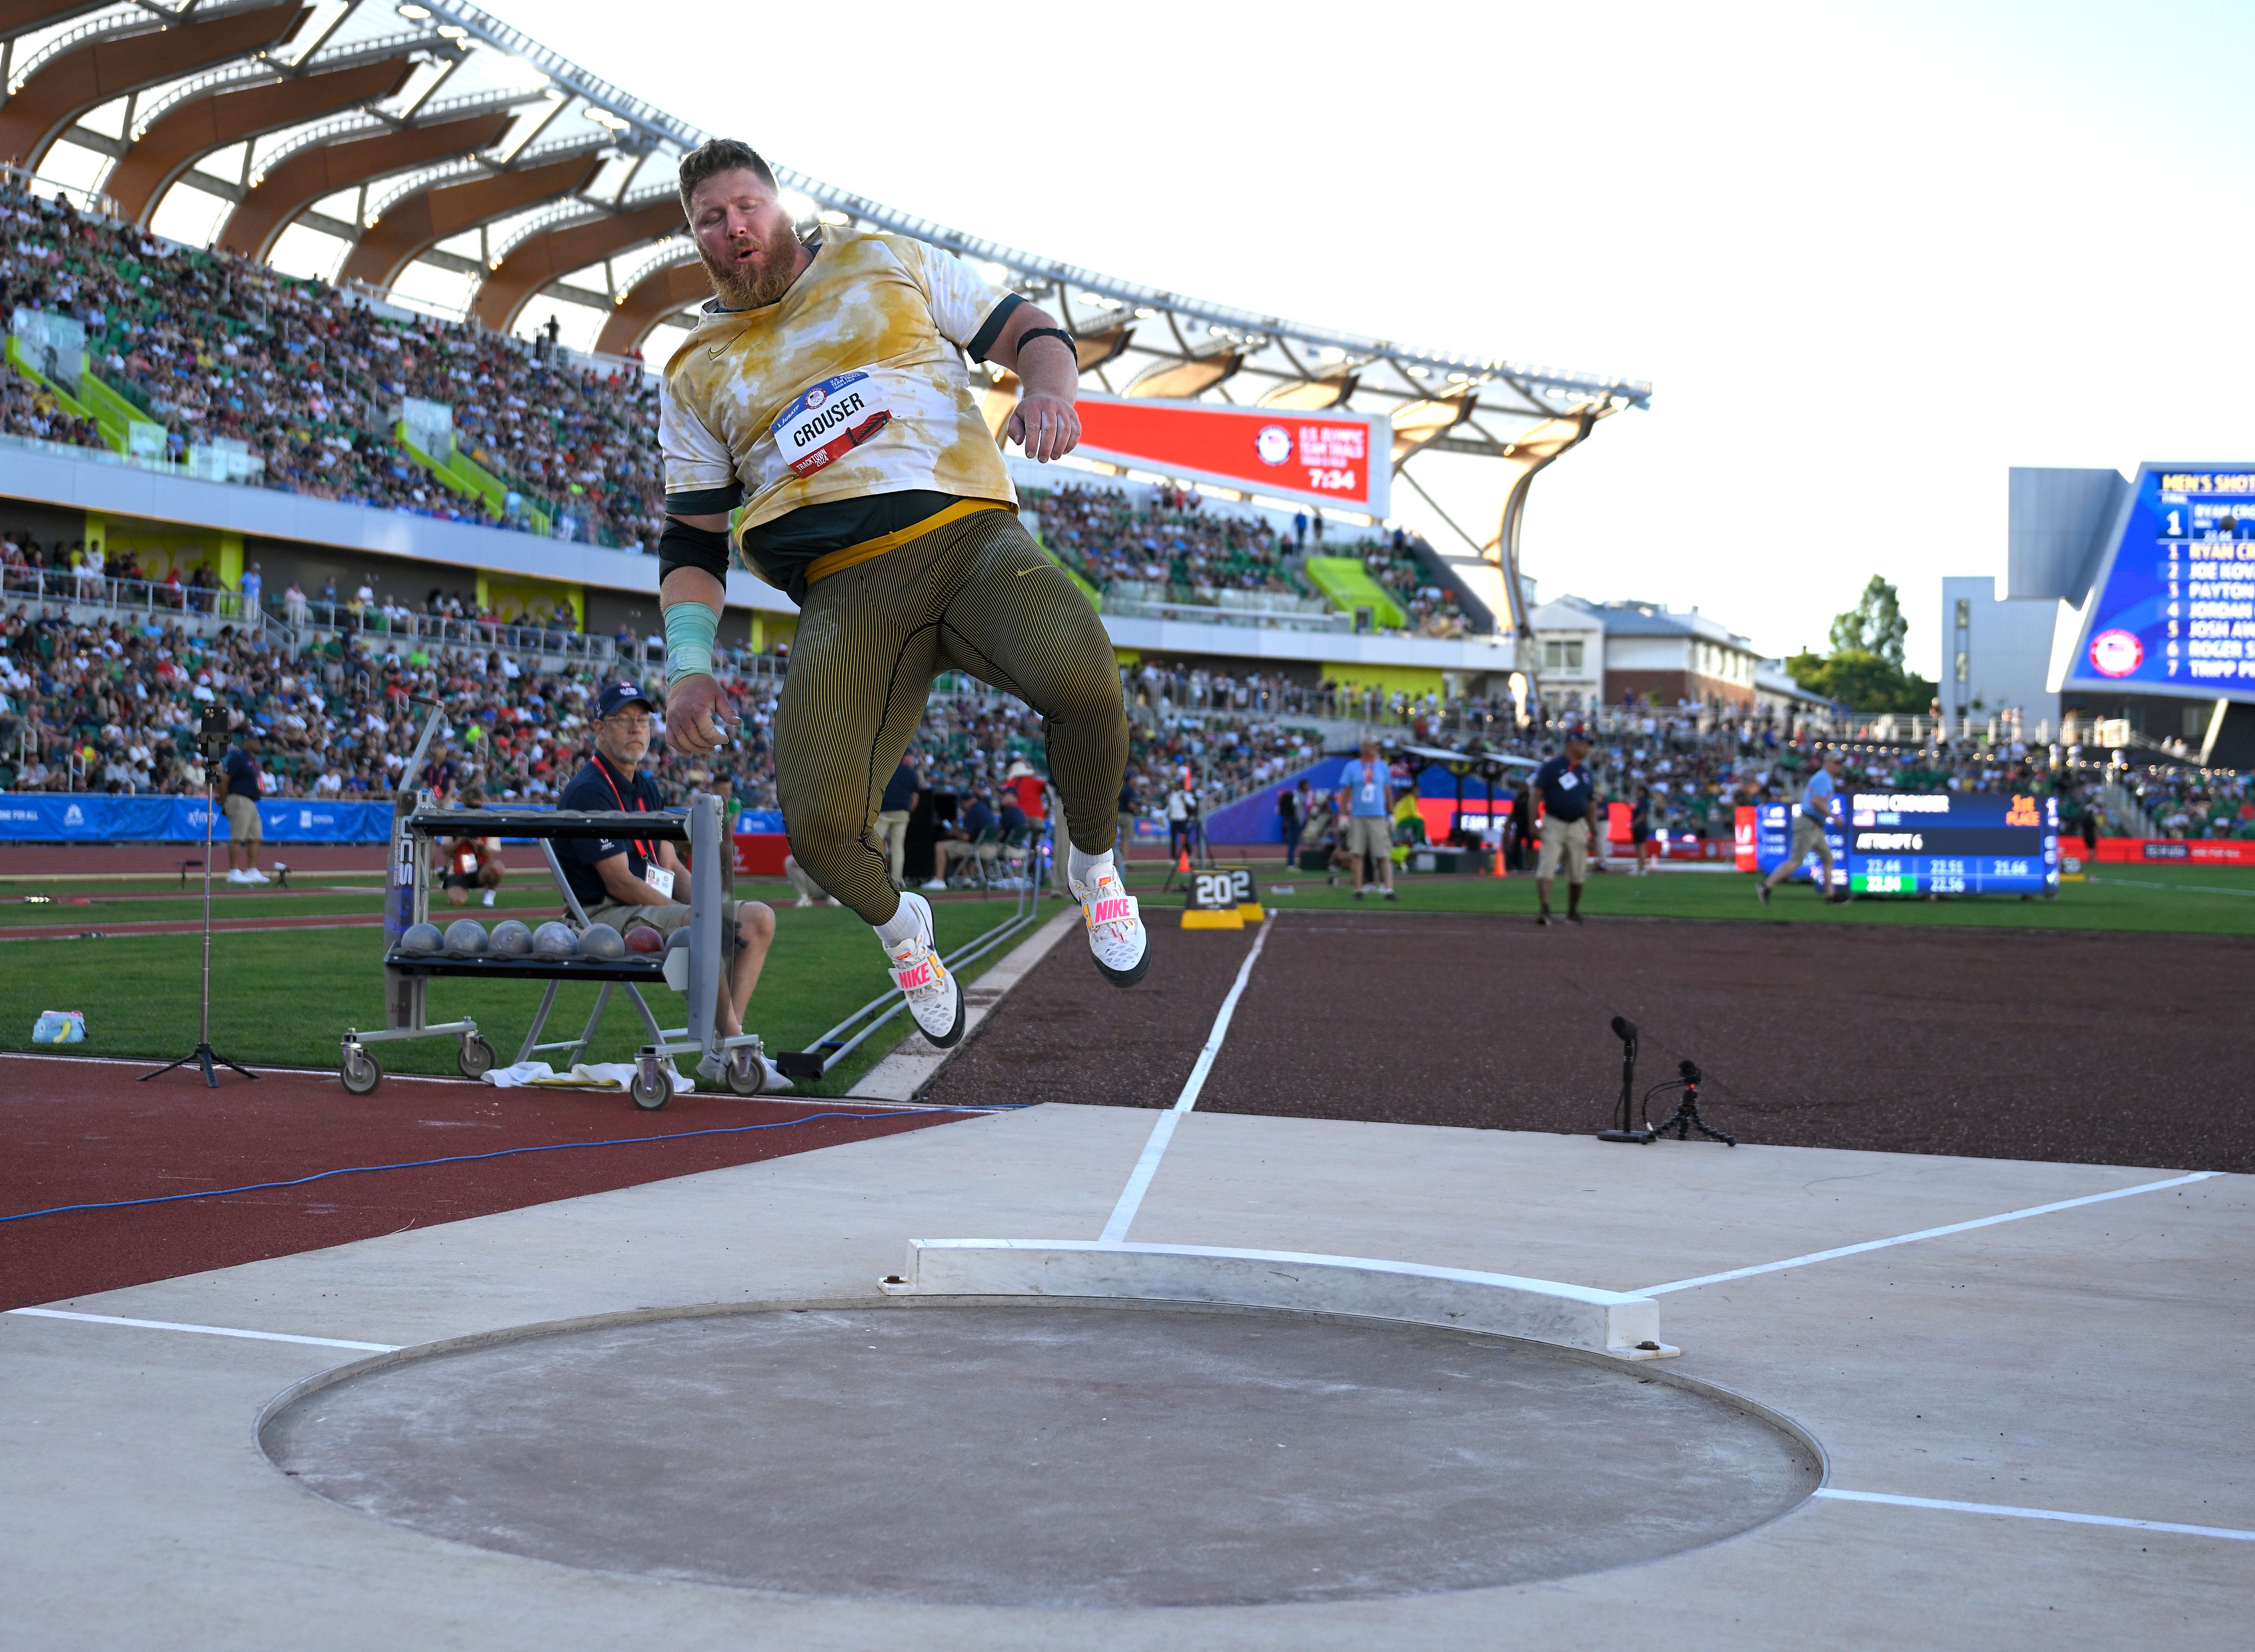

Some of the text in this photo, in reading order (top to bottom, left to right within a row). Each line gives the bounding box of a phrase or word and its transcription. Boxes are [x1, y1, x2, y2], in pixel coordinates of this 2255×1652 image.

[784, 404, 799, 422] USATF
[793, 392, 865, 447] CROUSER
[796, 448, 827, 471] TRACKTOWN
[815, 454, 829, 467] 2024
[1308, 469, 1356, 490] 7:34
[2166, 510, 2182, 535] 1
[2168, 542, 2179, 560] 1
[2189, 543, 2235, 560] RYAN
[2168, 561, 2255, 581] 2 JOE KOV
[2188, 581, 2255, 600] PAYTON
[2166, 600, 2253, 620] 4 JORDAN
[2168, 619, 2179, 638] 5
[2188, 620, 2230, 638] JOSH
[2166, 639, 2179, 657] 6
[2188, 639, 2243, 659] ROGER
[2166, 659, 2179, 677] 7
[2188, 659, 2237, 678] TRIPP
[187, 808, 219, 828] xfiniy
[2006, 811, 2040, 827] PLACE
[400, 815, 414, 885] UCS
[1912, 833, 1924, 850] 6
[1993, 860, 2028, 876] 21.66
[1095, 898, 1130, 924] NIKE
[899, 961, 931, 988] NIKE
